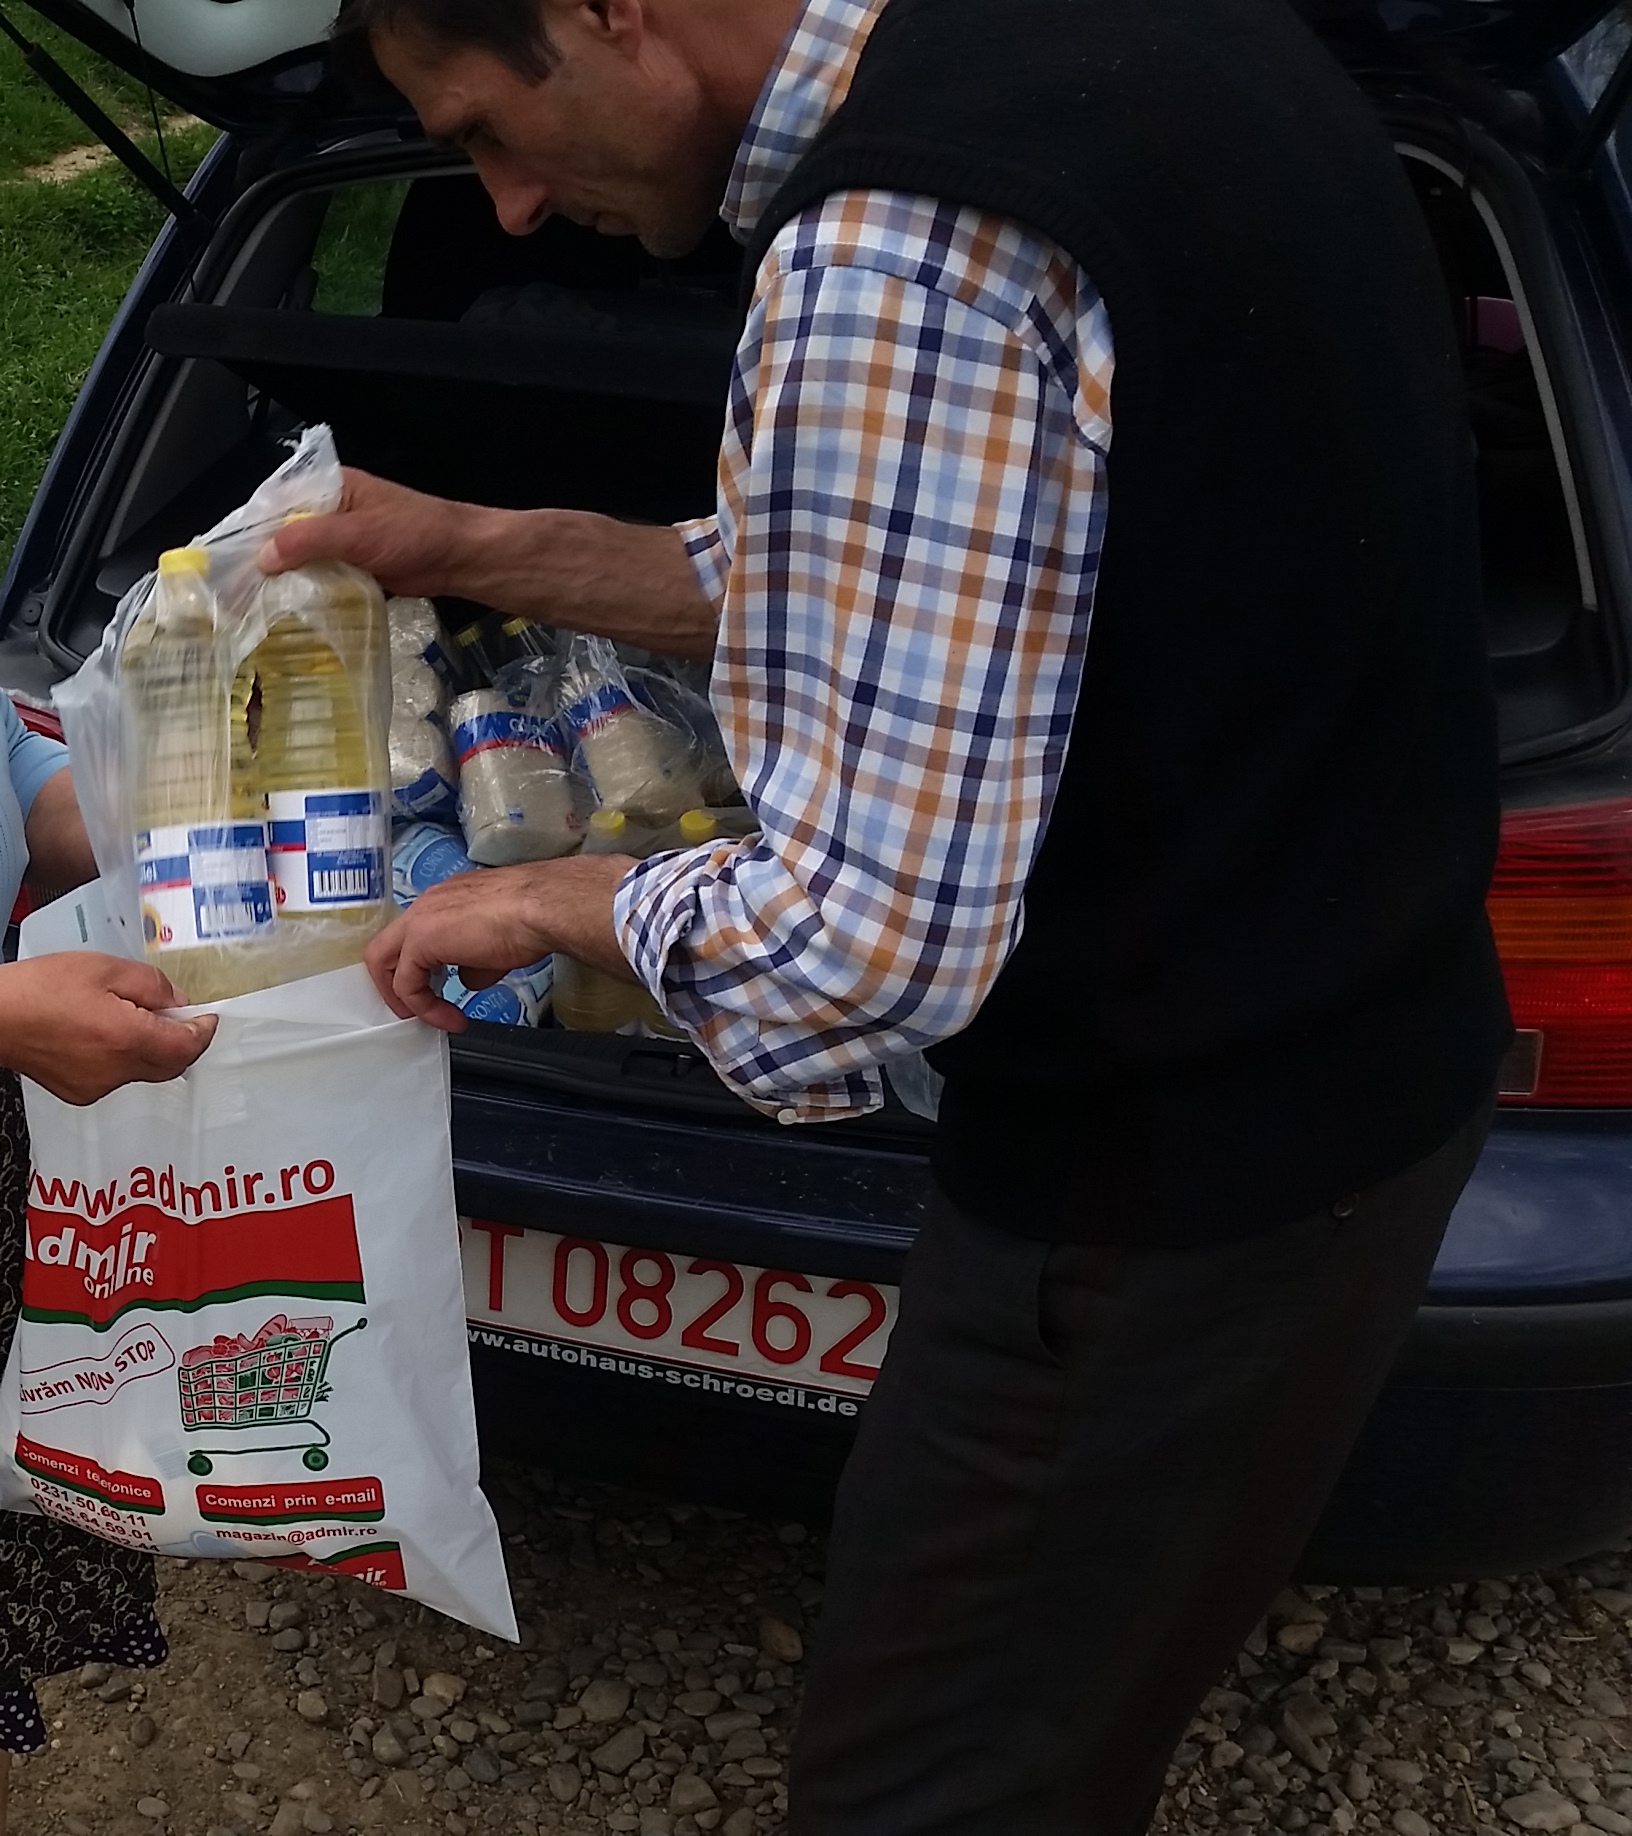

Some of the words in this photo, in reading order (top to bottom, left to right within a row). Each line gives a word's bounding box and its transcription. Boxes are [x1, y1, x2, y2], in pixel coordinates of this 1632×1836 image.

[458, 1217, 524, 1312] T
[552, 1235, 887, 1381] 08262
[74, 1371, 115, 1391] NON
[114, 1339, 156, 1373] STOP
[30, 1477, 147, 1527] 0231.50.60.11
[205, 1493, 276, 1508] Comenzi
[284, 1493, 317, 1509] prin
[324, 1488, 376, 1506] e-mail
[216, 1526, 378, 1546] magazin@admir.ro
